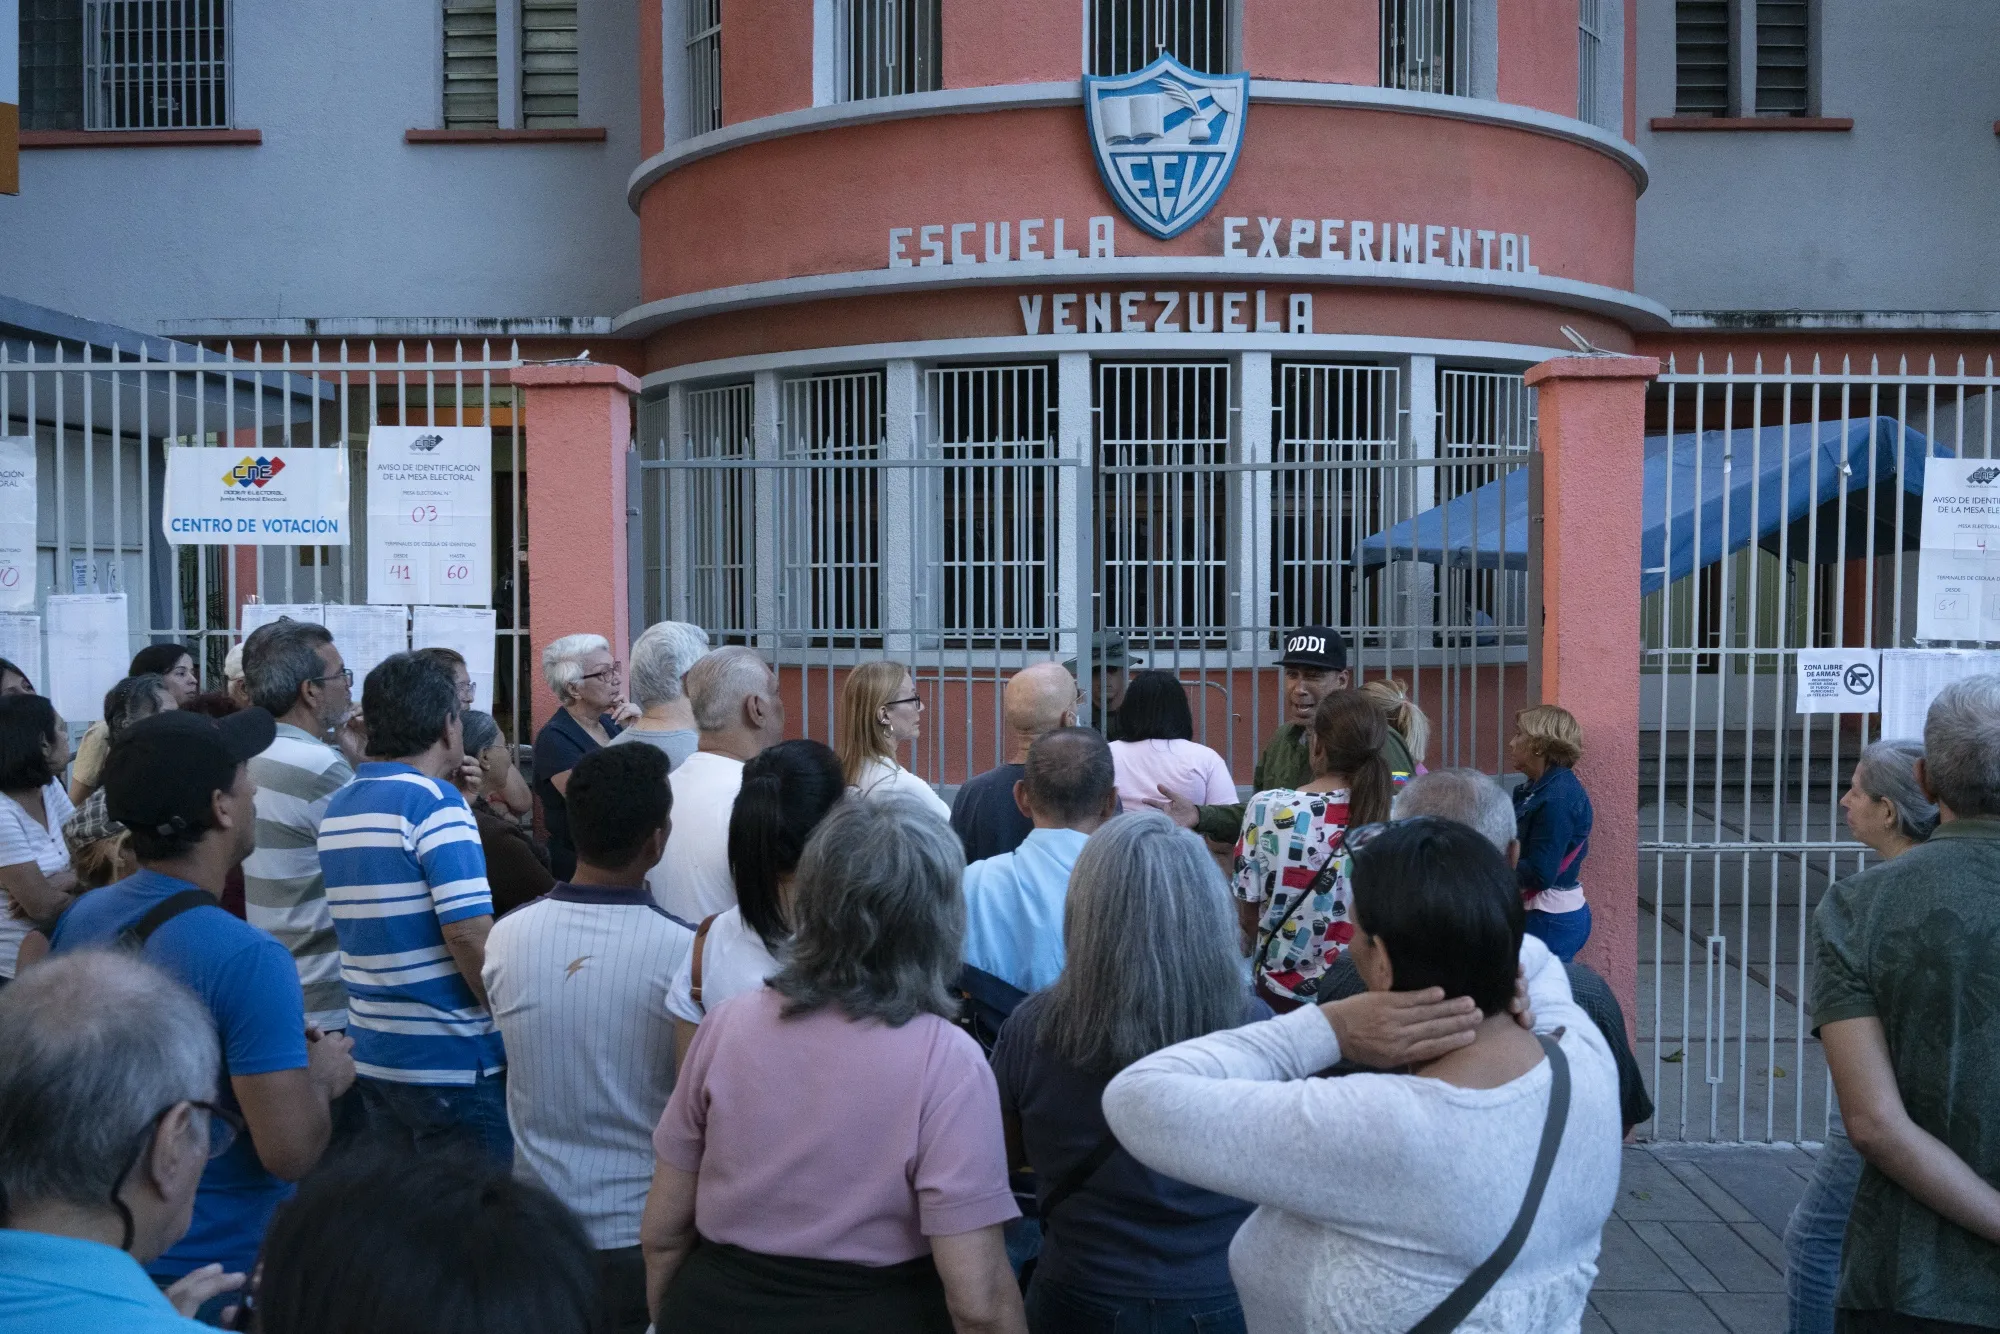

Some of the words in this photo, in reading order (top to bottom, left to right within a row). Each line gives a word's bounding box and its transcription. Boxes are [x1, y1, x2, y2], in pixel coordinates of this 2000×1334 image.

[1115, 155, 1221, 221] EEV
[889, 215, 1115, 268] ESCUELA
[1223, 217, 1539, 275] EXPERIMENTAL
[1018, 289, 1314, 335] VENEZUELA
[233, 465, 274, 479] CNE
[377, 463, 401, 471] AVISO
[415, 463, 481, 472] IDENTIFICACIÓN
[407, 473, 428, 481] MESA
[429, 473, 475, 481] ELECTORAL
[1932, 496, 1957, 504] AVISO
[1958, 496, 1970, 504] DE
[411, 505, 438, 523] 03
[1963, 506, 1985, 514] MESA
[171, 518, 233, 533] CENTRO
[237, 518, 256, 533] DE
[262, 515, 338, 533] VOTACIÓN
[1976, 539, 1986, 555] 4
[389, 565, 411, 580] 41
[447, 564, 469, 580] 60
[1287, 635, 1326, 654] ODDI
